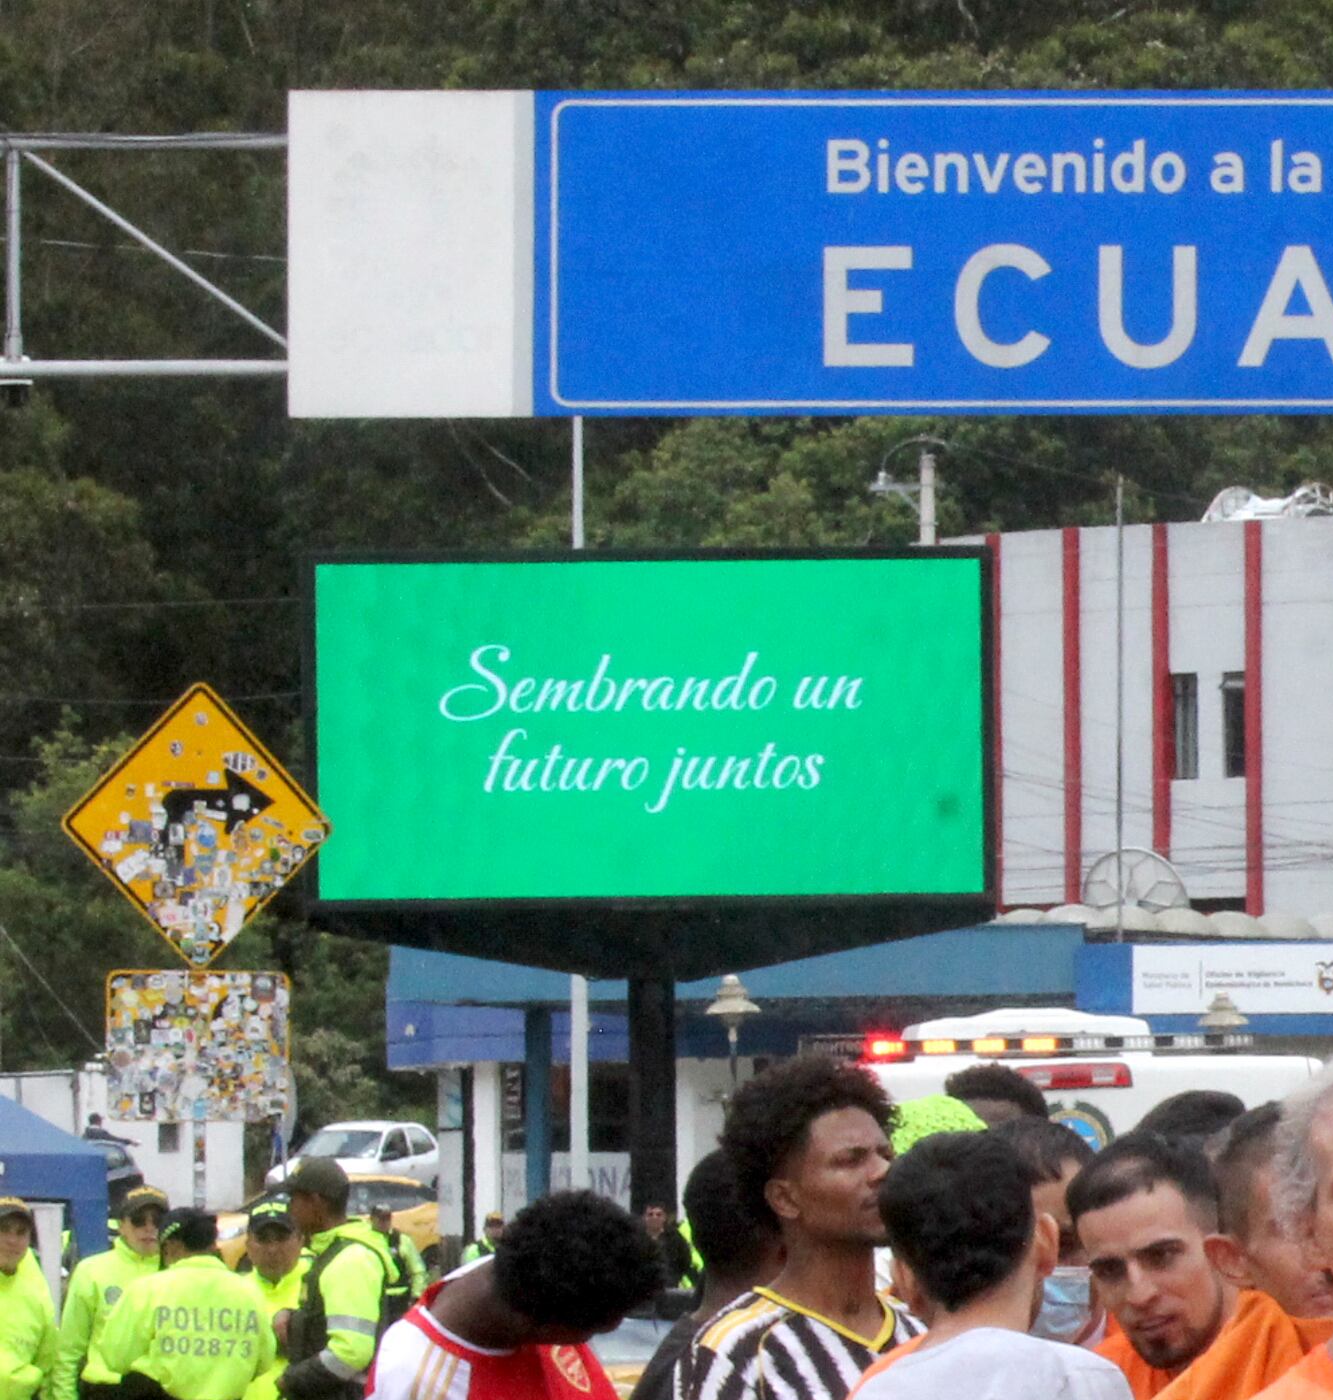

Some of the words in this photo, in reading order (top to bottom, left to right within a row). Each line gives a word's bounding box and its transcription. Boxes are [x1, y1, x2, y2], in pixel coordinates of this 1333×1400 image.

[825, 138, 1186, 195] Bienvenido
[1210, 152, 1245, 195] a
[1270, 138, 1324, 195] la
[439, 644, 778, 722] Sembrando
[792, 674, 864, 711] un
[482, 728, 650, 793] futuro
[644, 742, 826, 814] juntos
[156, 1305, 261, 1335] POLICIA
[160, 1336, 252, 1359] 002873
